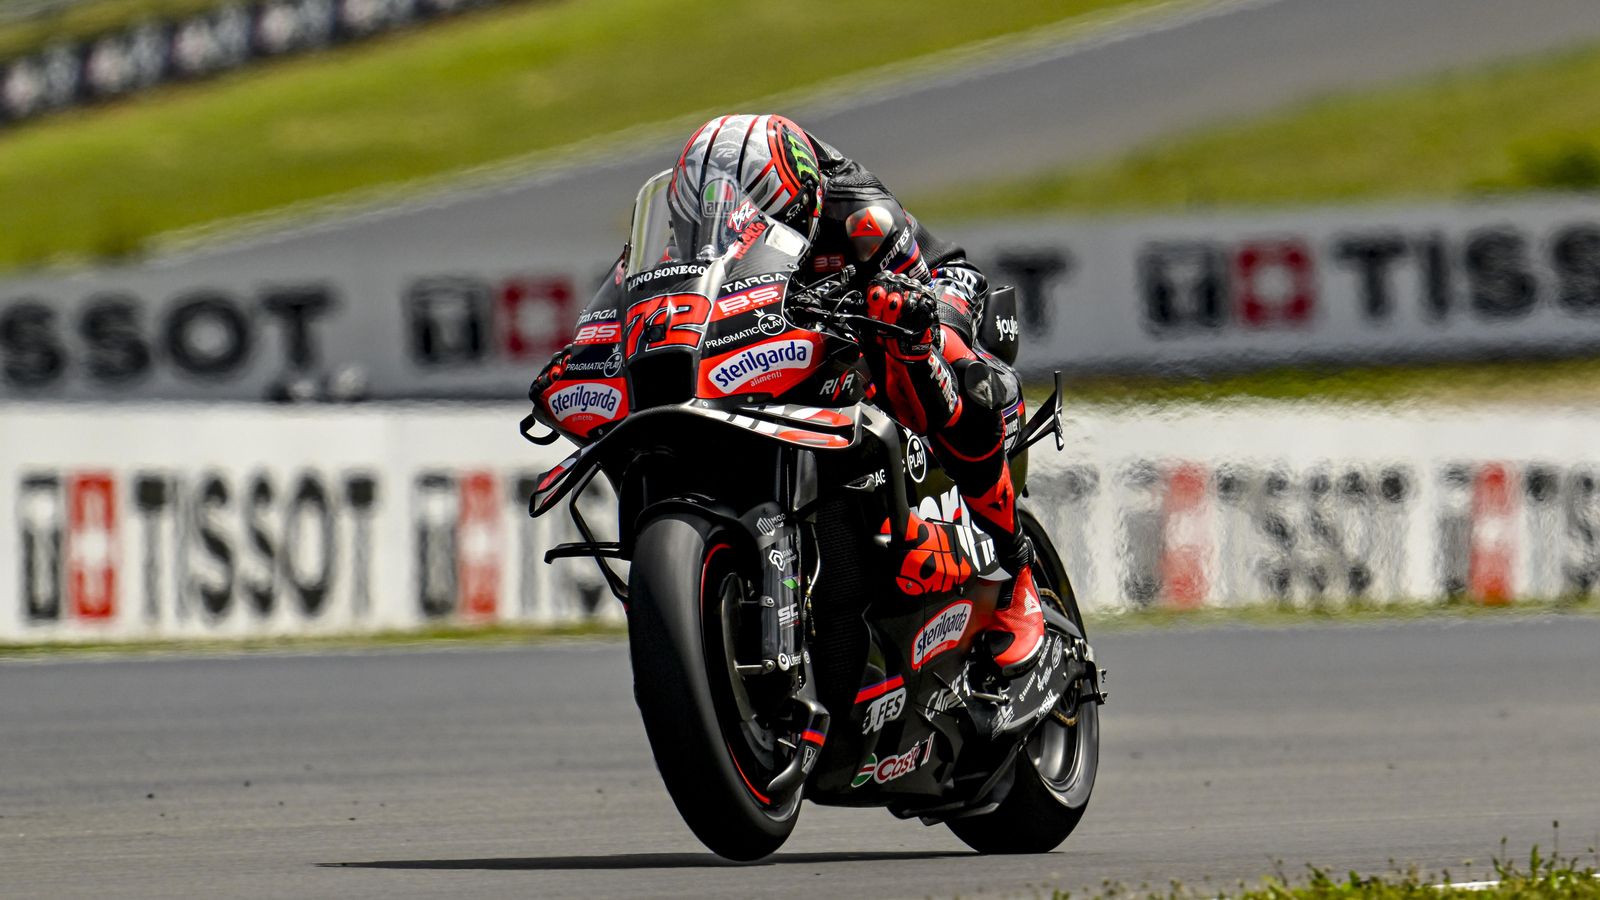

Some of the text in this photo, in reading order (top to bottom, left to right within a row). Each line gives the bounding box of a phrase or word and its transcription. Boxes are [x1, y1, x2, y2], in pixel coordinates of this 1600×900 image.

[627, 271, 653, 291] LINO
[654, 264, 707, 279] SONEGO
[721, 271, 788, 293] TARGA
[718, 286, 779, 313] BS
[578, 308, 617, 324] TARGA
[625, 292, 713, 360] 72
[575, 324, 619, 340] BS
[704, 319, 783, 348] PRAGMATIC PLAY
[565, 362, 605, 372] PRAGMATIC
[715, 341, 807, 387] sterilgarda
[750, 371, 783, 388] alimenti
[551, 385, 617, 415] sterilgarda
[908, 450, 925, 469] PLAY
[136, 472, 380, 620] TISSOT
[916, 605, 968, 657] sterilgarda
